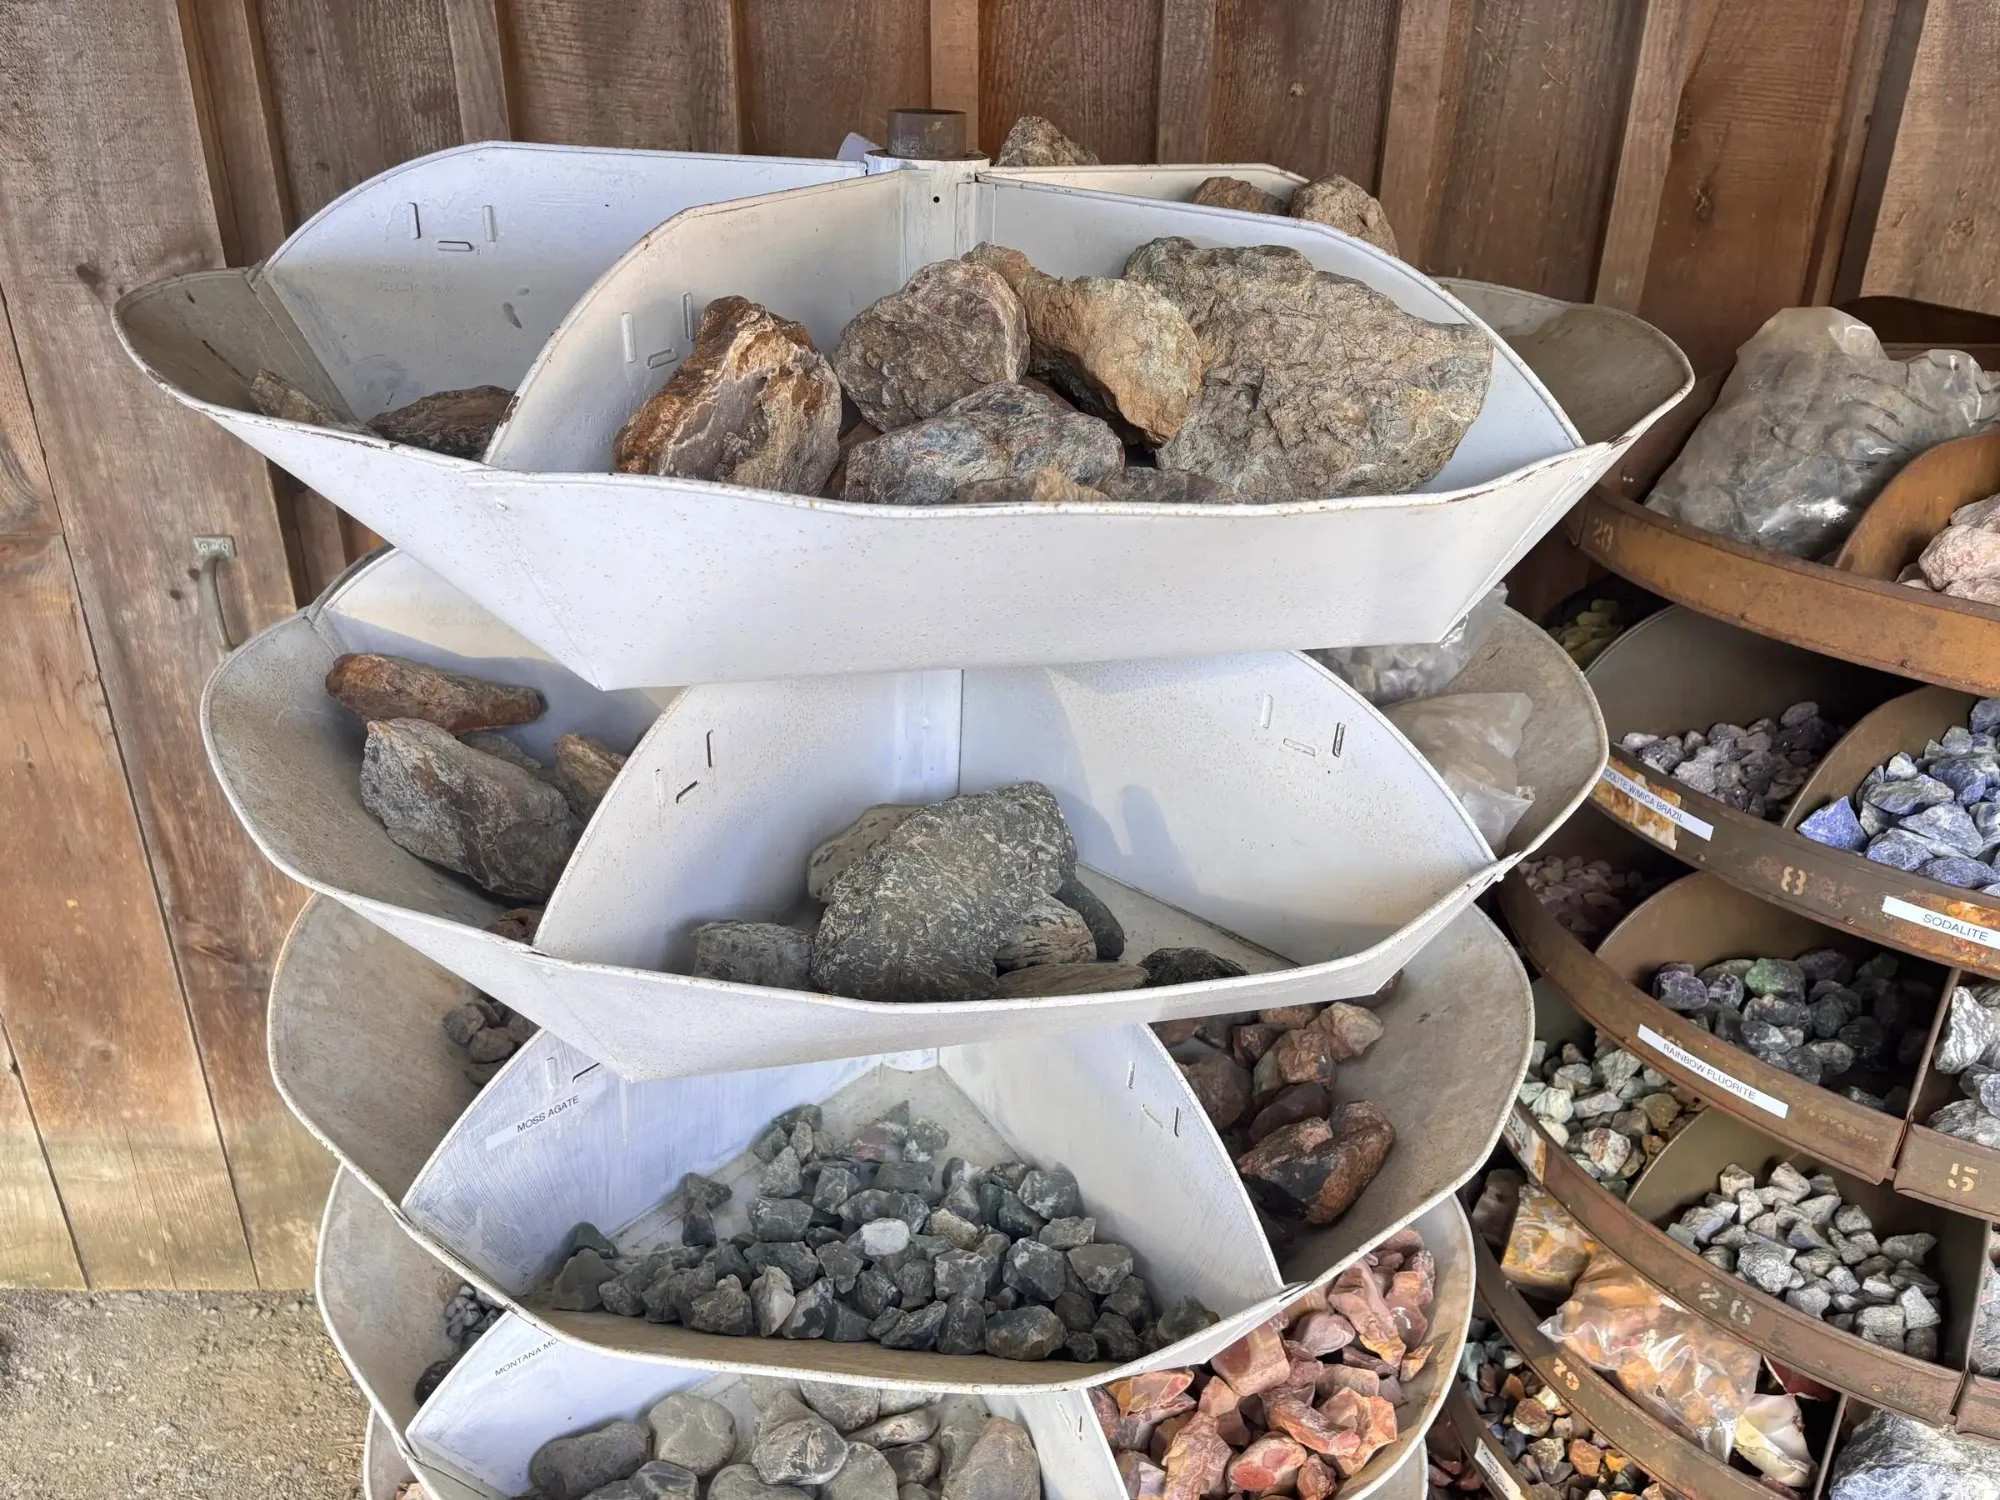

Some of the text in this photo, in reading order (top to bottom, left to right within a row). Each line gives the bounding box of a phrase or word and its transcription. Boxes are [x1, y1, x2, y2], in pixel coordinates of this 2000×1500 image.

[1602, 767, 1628, 791] IDOLITE
[1656, 801, 1684, 823] BRAZIL
[1923, 913, 1989, 942] SODALITE
[1662, 1042, 1757, 1100] RAINBOW FLUORITE
[517, 1095, 580, 1133] MOSS AGATE
[494, 1337, 559, 1377] MONTANA MO
